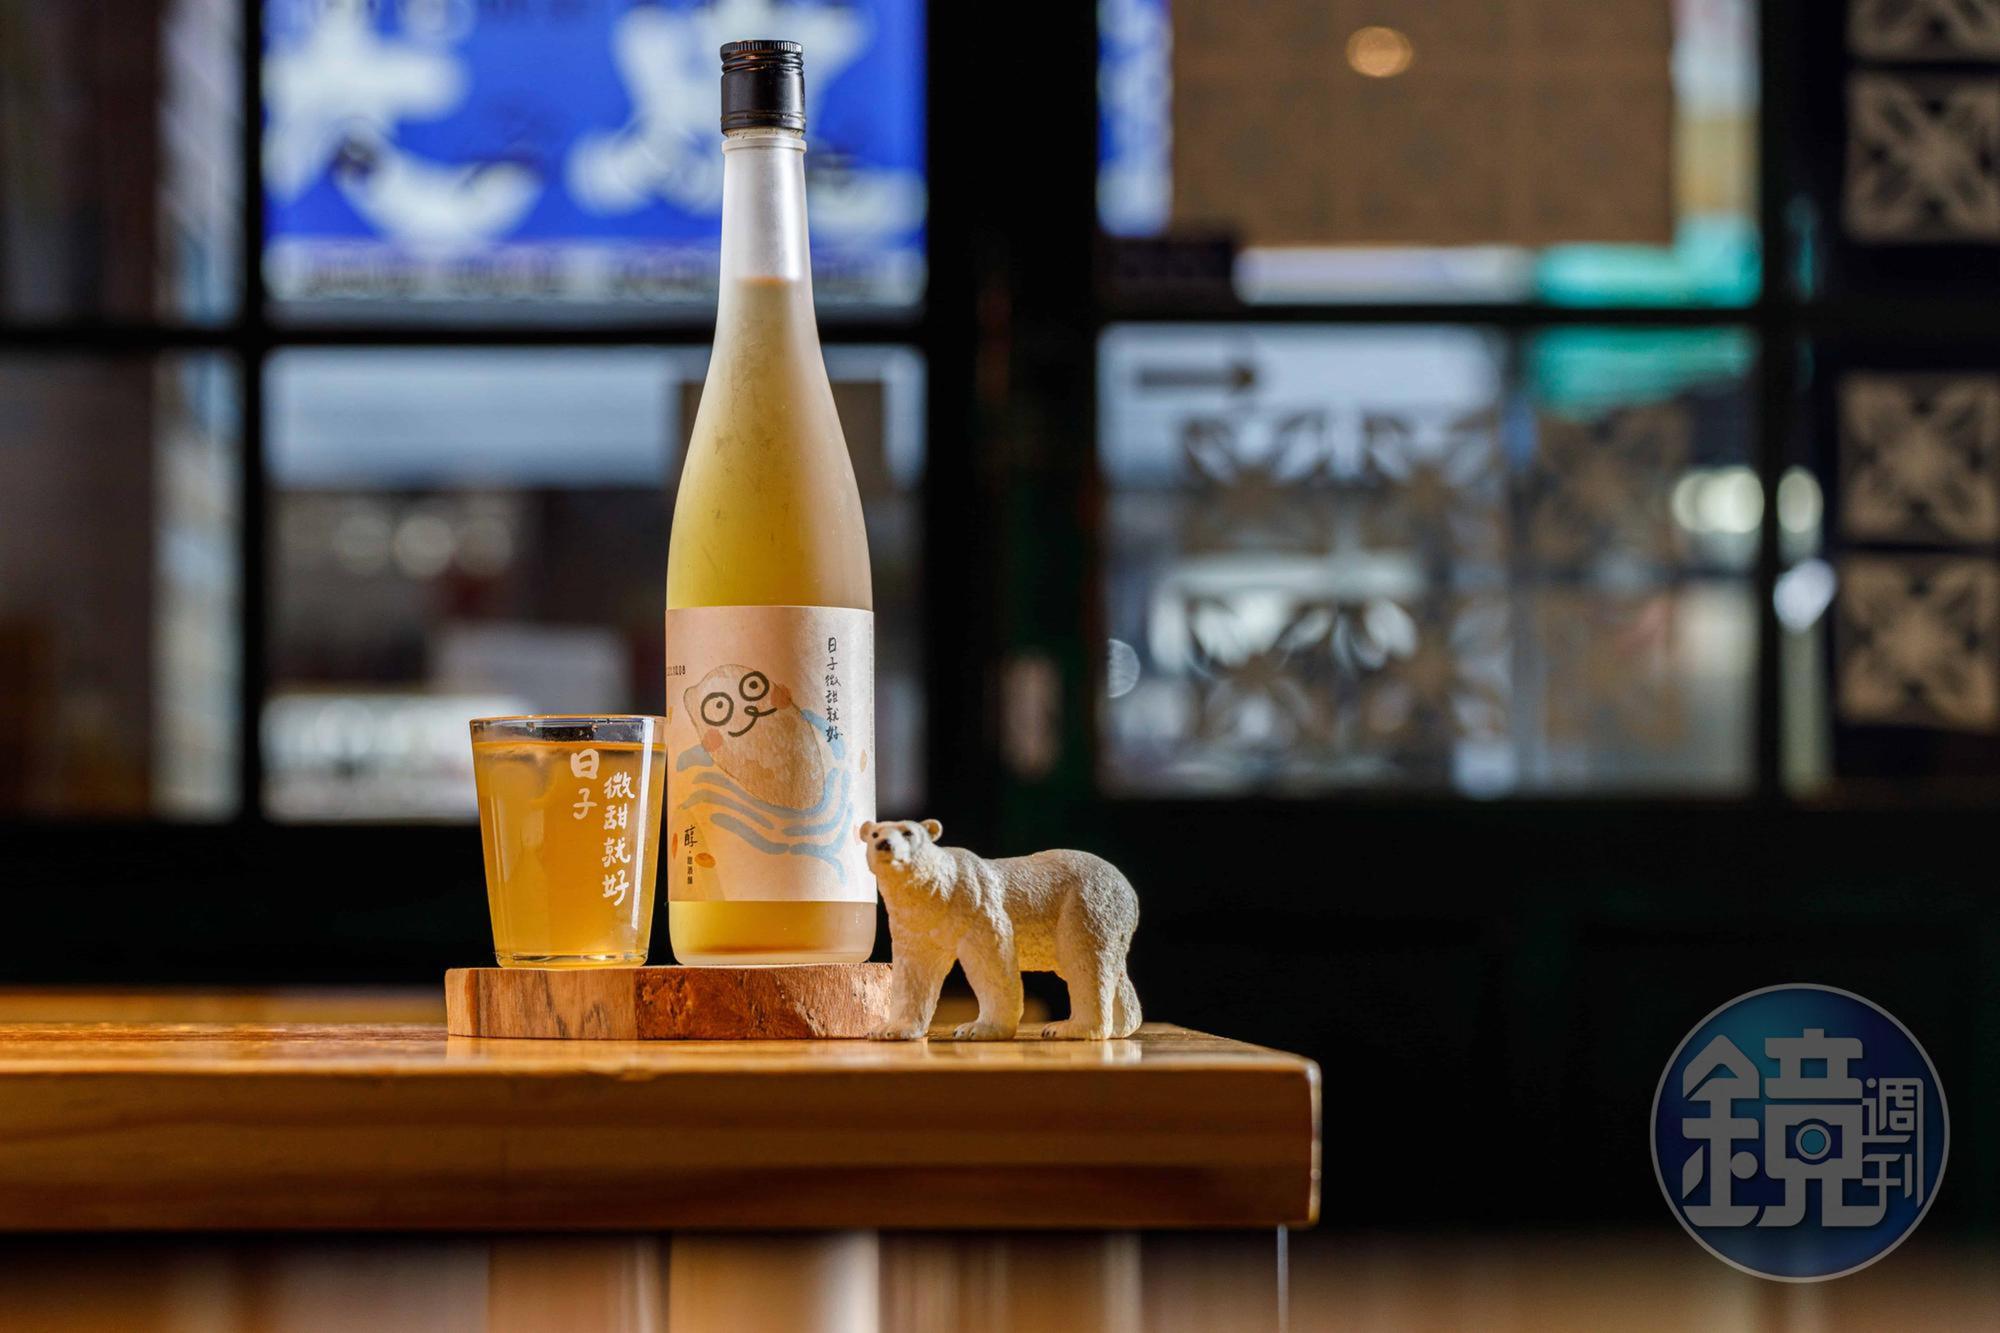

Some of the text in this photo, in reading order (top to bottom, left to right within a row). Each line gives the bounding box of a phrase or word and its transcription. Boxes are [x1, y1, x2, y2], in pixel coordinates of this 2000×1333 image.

[825, 637, 843, 742] 日子微甜就好
[570, 748, 600, 820] 日子
[601, 771, 636, 907] 微甜就好
